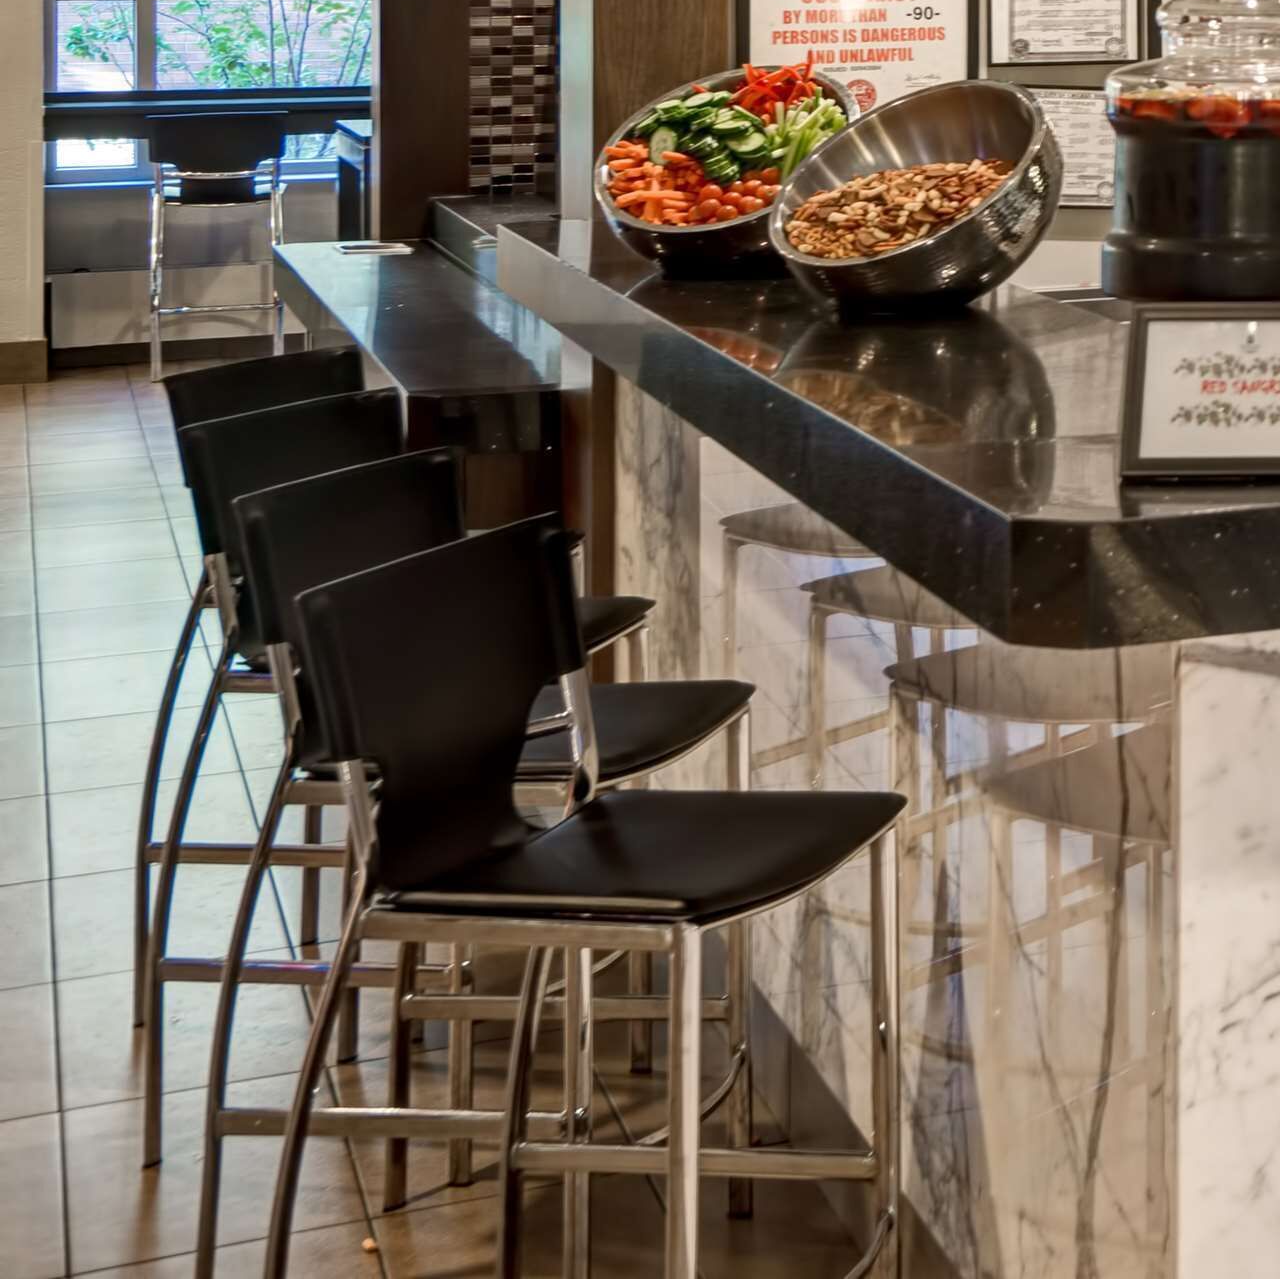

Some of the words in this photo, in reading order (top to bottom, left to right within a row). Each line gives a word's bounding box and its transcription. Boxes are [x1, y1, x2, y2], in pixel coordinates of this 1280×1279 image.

[783, 9, 801, 24] BY
[906, 6, 941, 20] -90-
[771, 29, 839, 45] PERSONS
[843, 28, 857, 43] IS
[861, 26, 946, 42] DANGEROUS
[806, 49, 836, 64] AND
[839, 47, 914, 63] UNLAWFUL
[1200, 379, 1227, 394] RED
